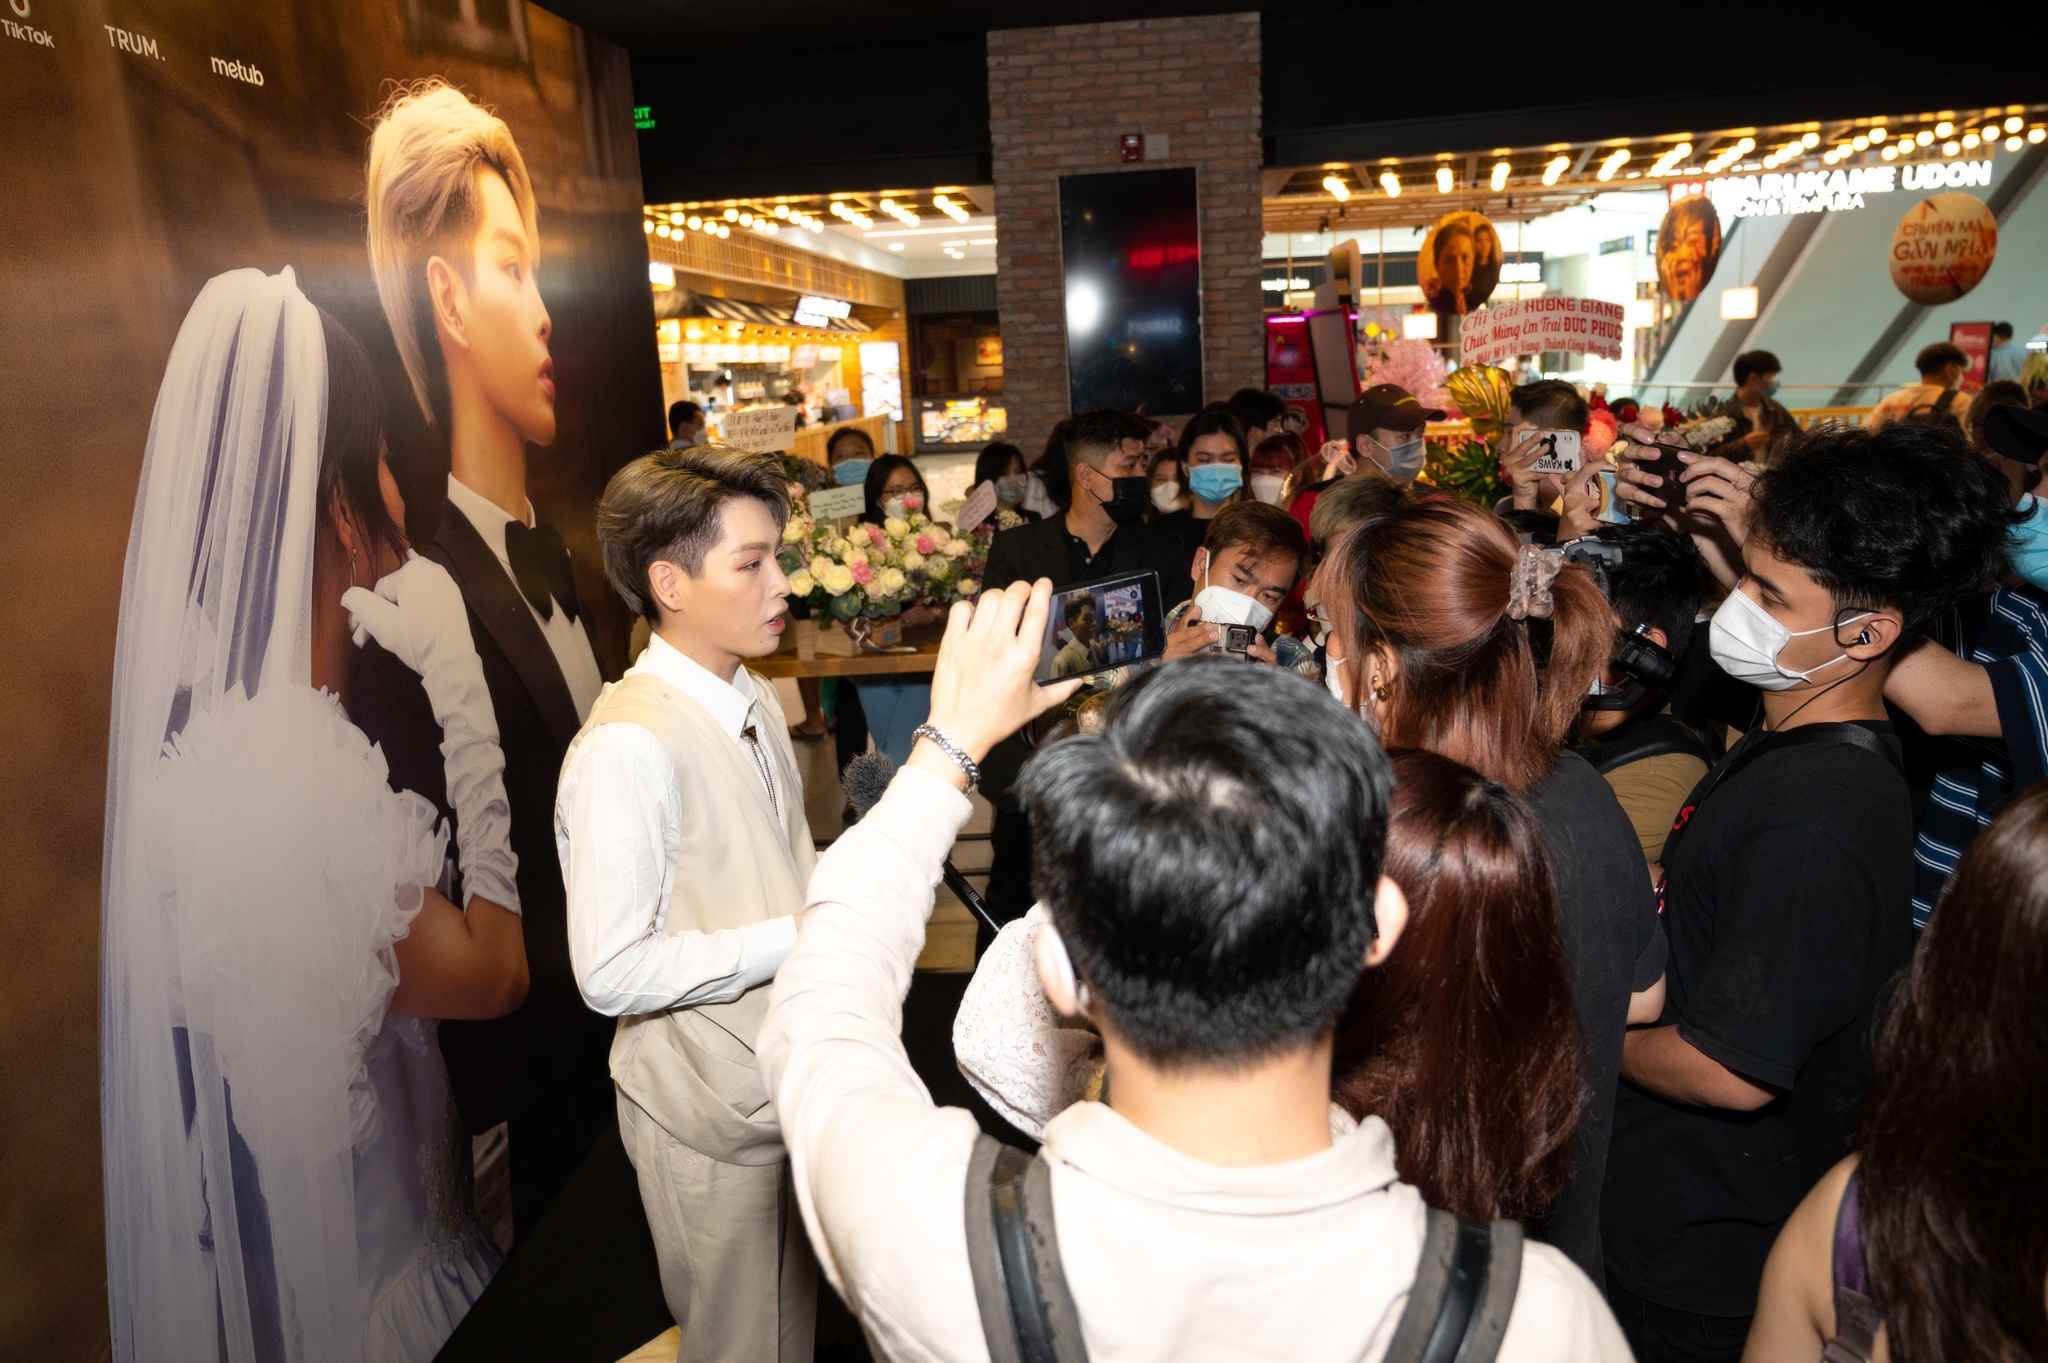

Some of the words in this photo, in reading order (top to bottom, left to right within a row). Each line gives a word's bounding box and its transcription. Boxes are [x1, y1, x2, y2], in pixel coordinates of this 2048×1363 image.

[1, 19, 55, 48] TikTok
[211, 55, 265, 86] metub
[1901, 160, 1992, 190] UDON
[1781, 193, 1866, 214] TEMPURA
[1463, 310, 1487, 332] Chị
[1524, 296, 1576, 313] HƯƠNG
[1581, 298, 1624, 320] GIANG
[1464, 329, 1489, 353] Chúc
[1491, 322, 1521, 342] Mừng
[1523, 318, 1539, 335] Em
[1540, 316, 1562, 332] Trai
[1564, 314, 1587, 333] ĐỨC
[1591, 318, 1623, 341] PHÚC
[1493, 344, 1507, 358] MV
[1587, 340, 1607, 356] Mong
[1538, 458, 1563, 470] KAWS
